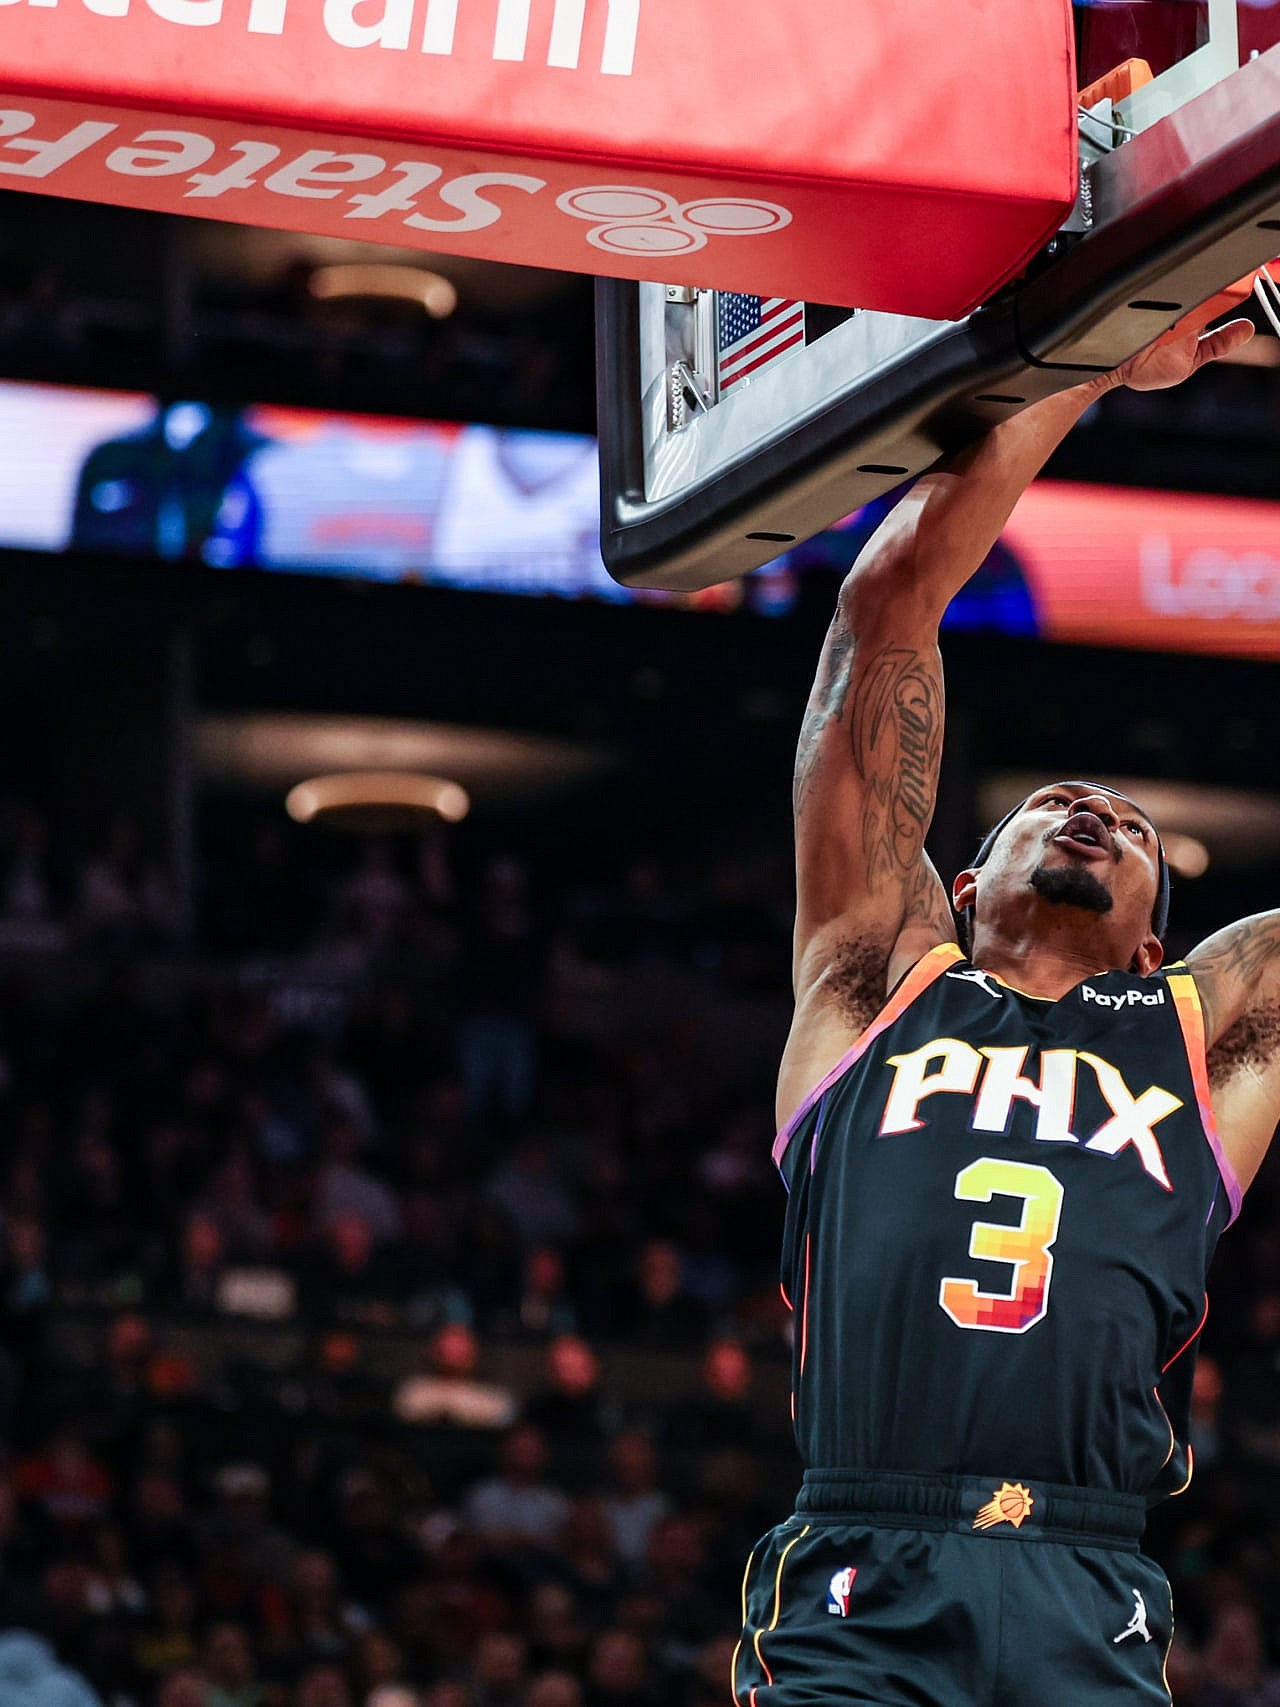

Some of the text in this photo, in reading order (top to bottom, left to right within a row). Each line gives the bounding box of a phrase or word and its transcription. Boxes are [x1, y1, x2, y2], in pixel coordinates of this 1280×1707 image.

[1081, 984, 1165, 1011] PayPal
[878, 1037, 1184, 1192] PHX
[938, 1157, 1064, 1334] 3
